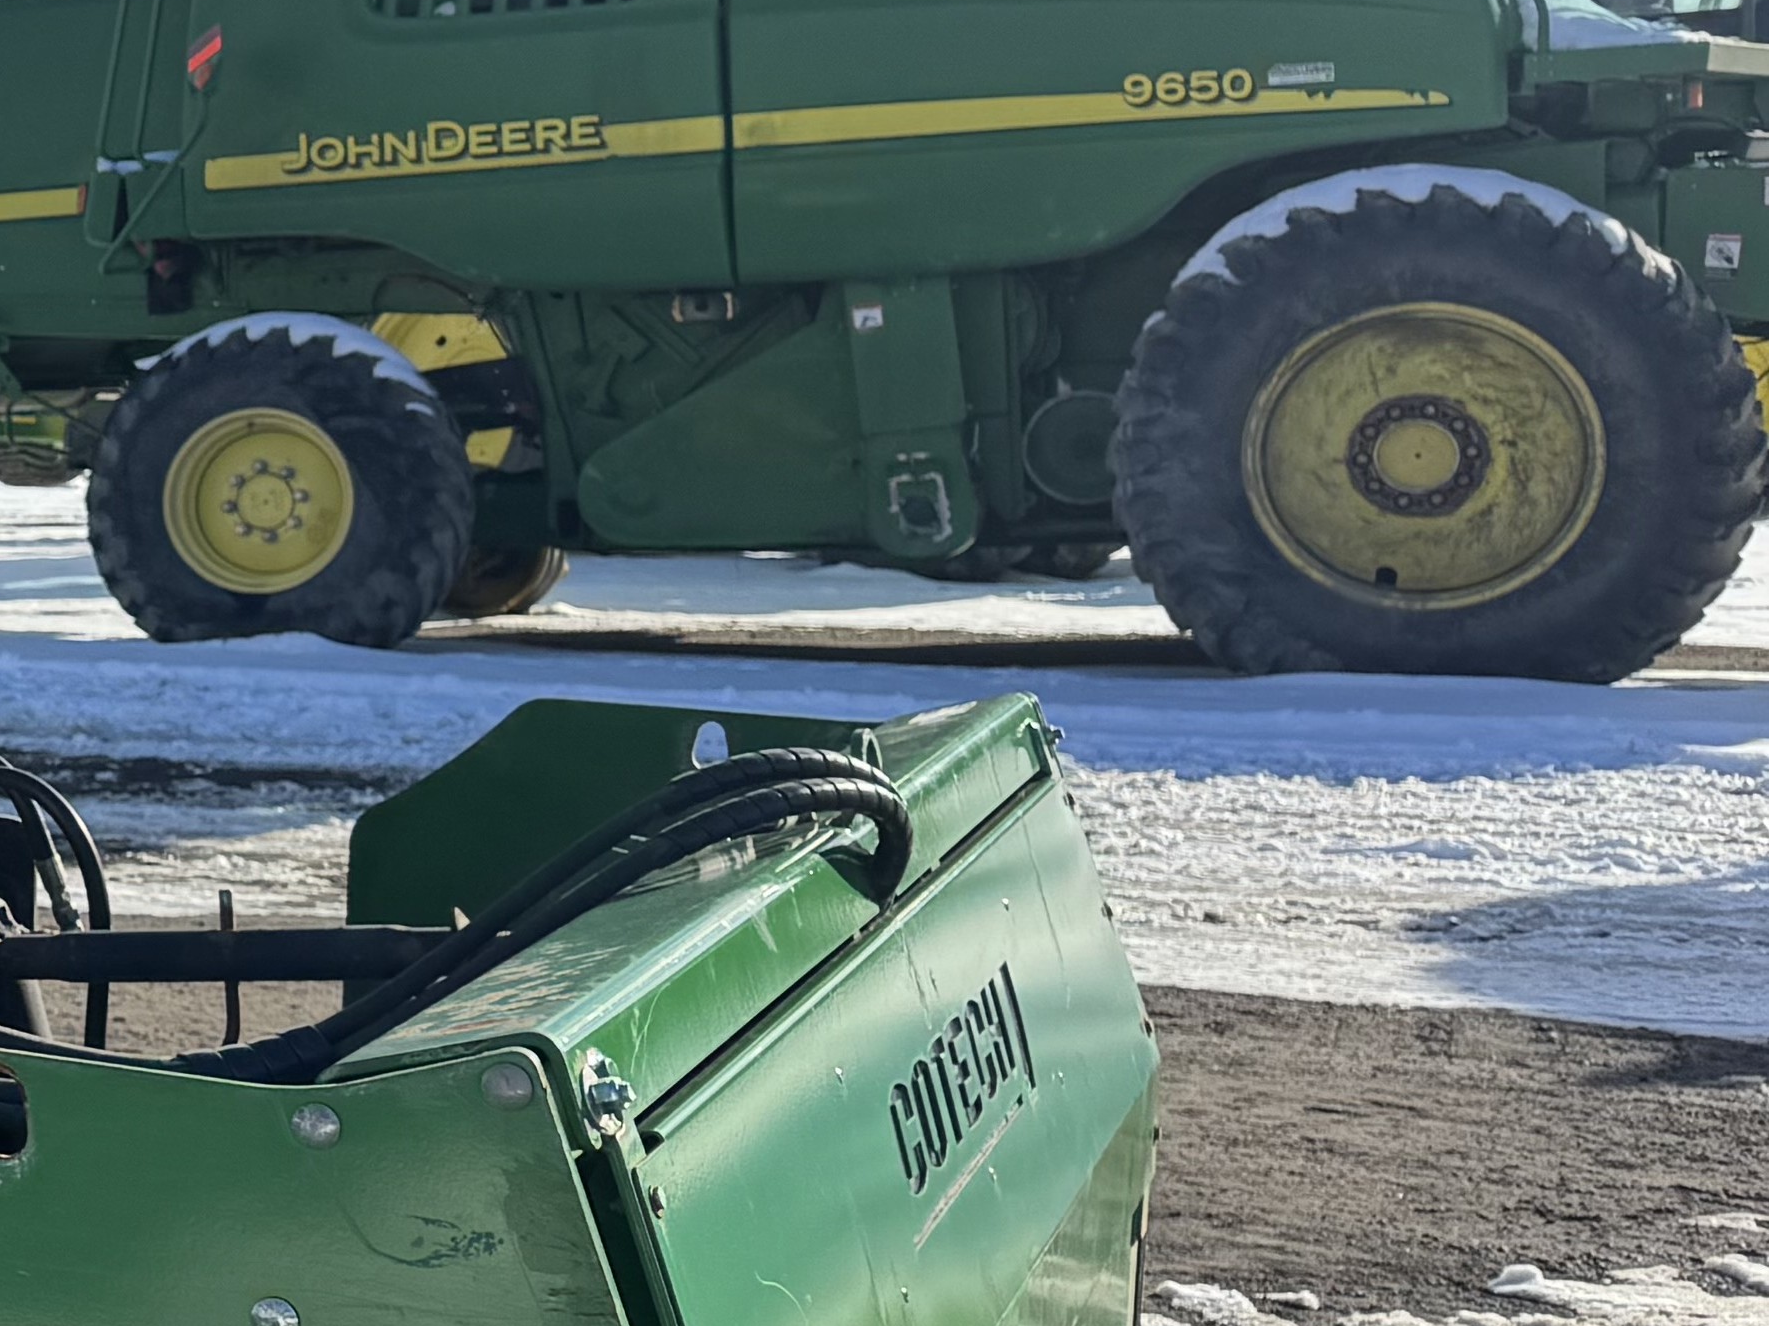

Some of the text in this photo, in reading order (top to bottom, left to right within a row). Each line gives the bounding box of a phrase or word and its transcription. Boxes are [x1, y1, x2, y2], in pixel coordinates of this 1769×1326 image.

[1123, 67, 1254, 106] 9650
[281, 114, 603, 174] JOHN DEERE
[889, 977, 1017, 1196] COTECH
